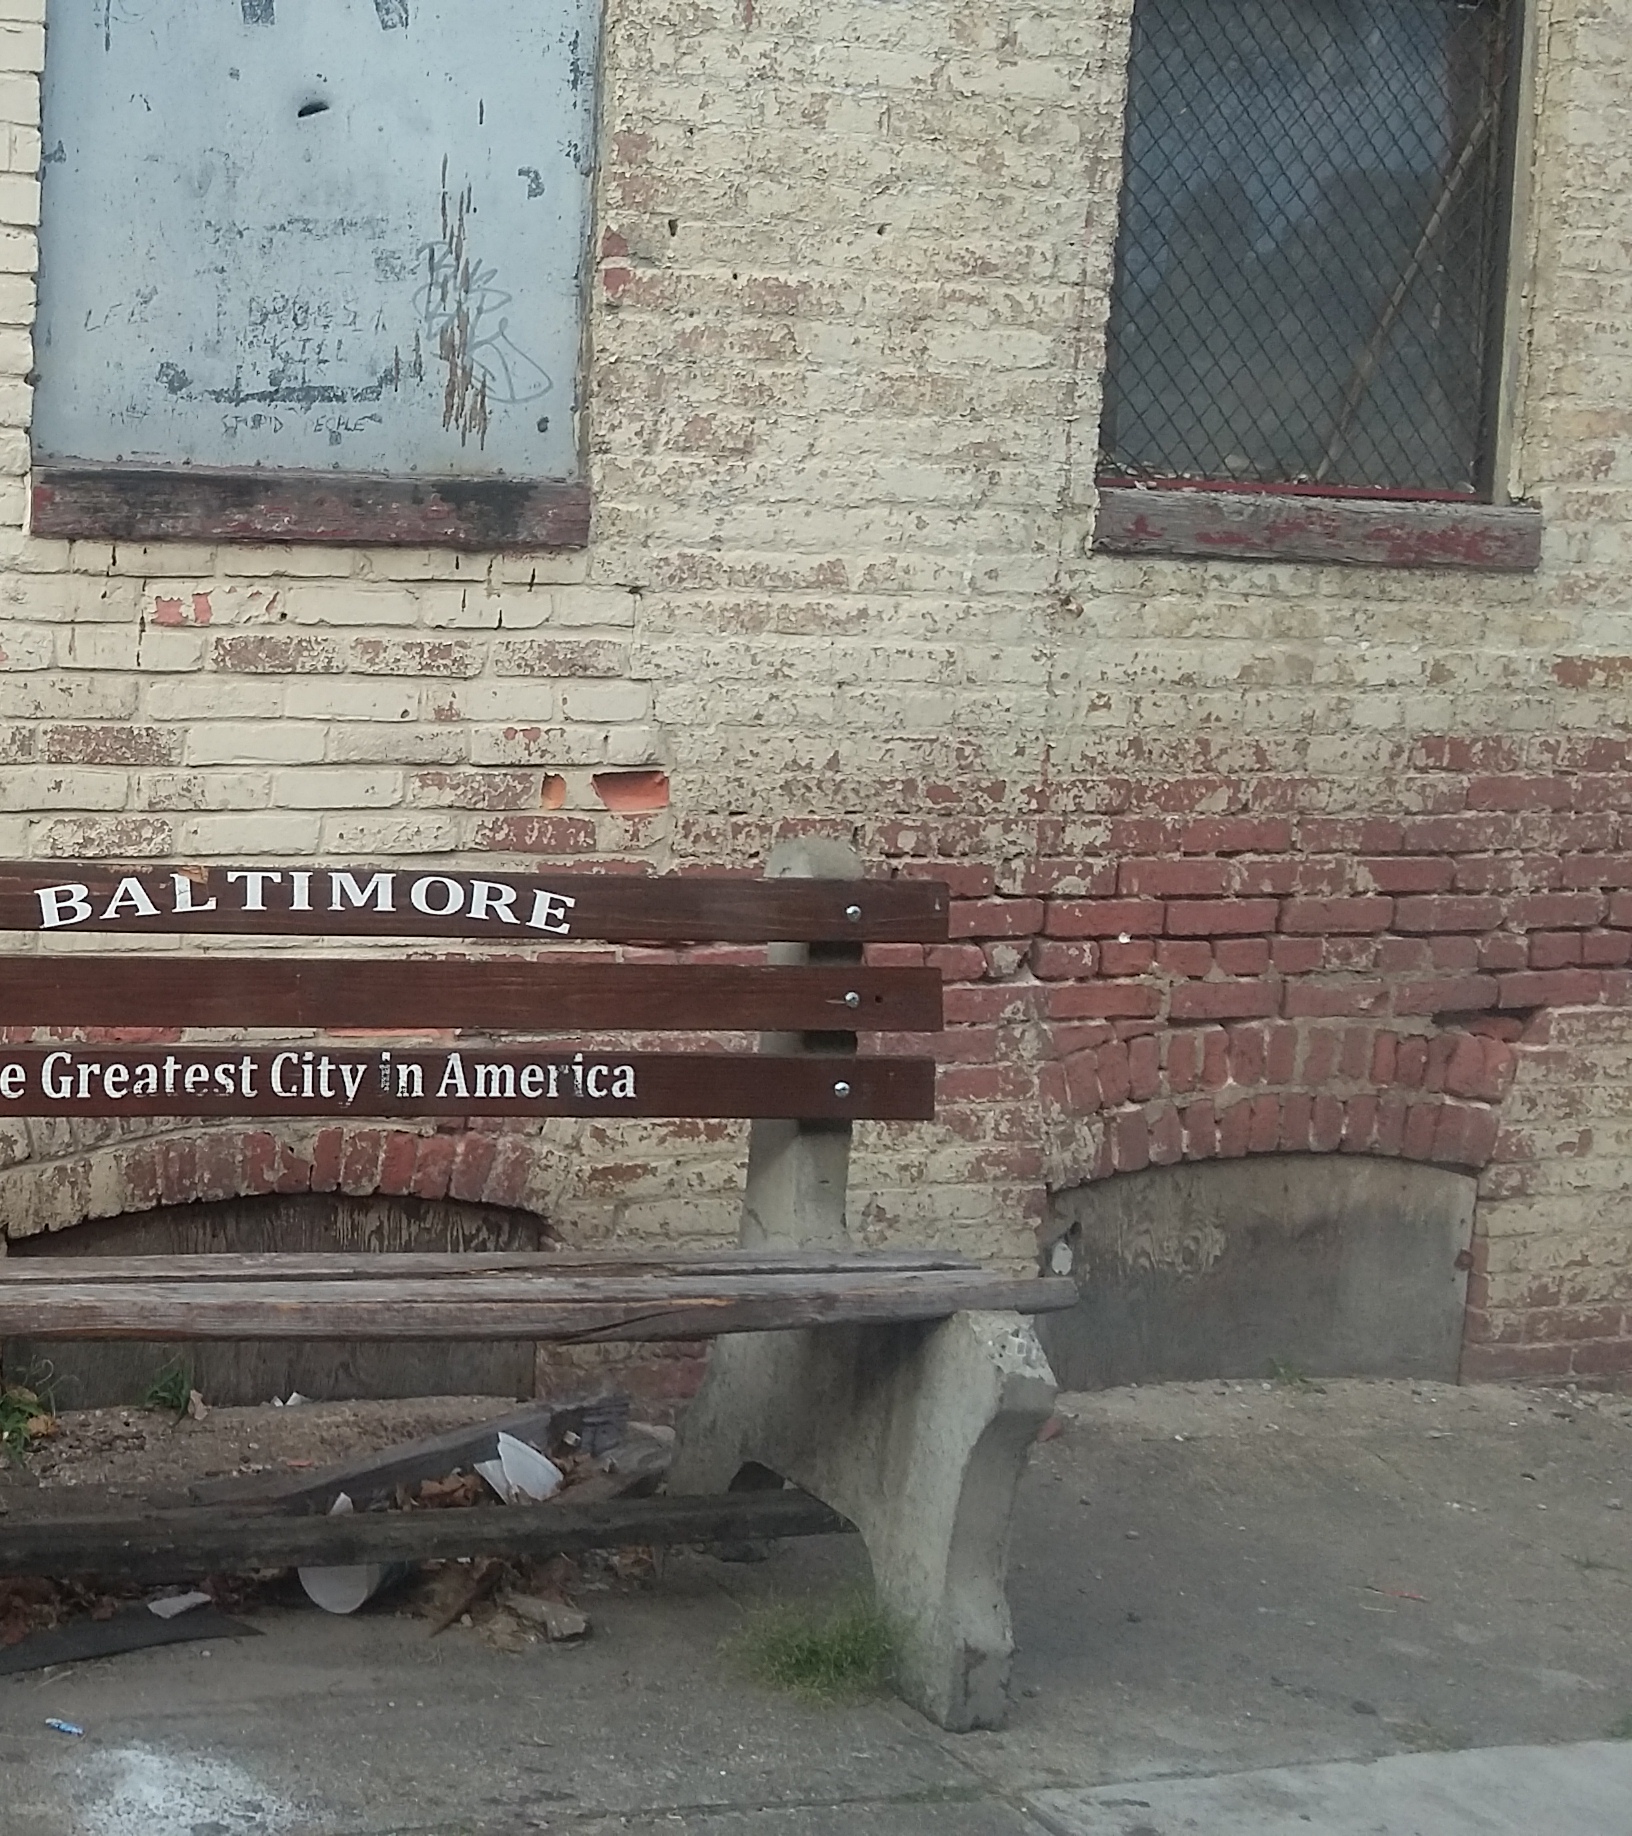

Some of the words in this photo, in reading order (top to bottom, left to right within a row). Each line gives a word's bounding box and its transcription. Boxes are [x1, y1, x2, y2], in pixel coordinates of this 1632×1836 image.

[34, 871, 577, 935] BALTIMORE
[41, 1051, 259, 1099] Greatest
[270, 1051, 368, 1108] City
[379, 1051, 425, 1099] in
[435, 1052, 637, 1099] America
